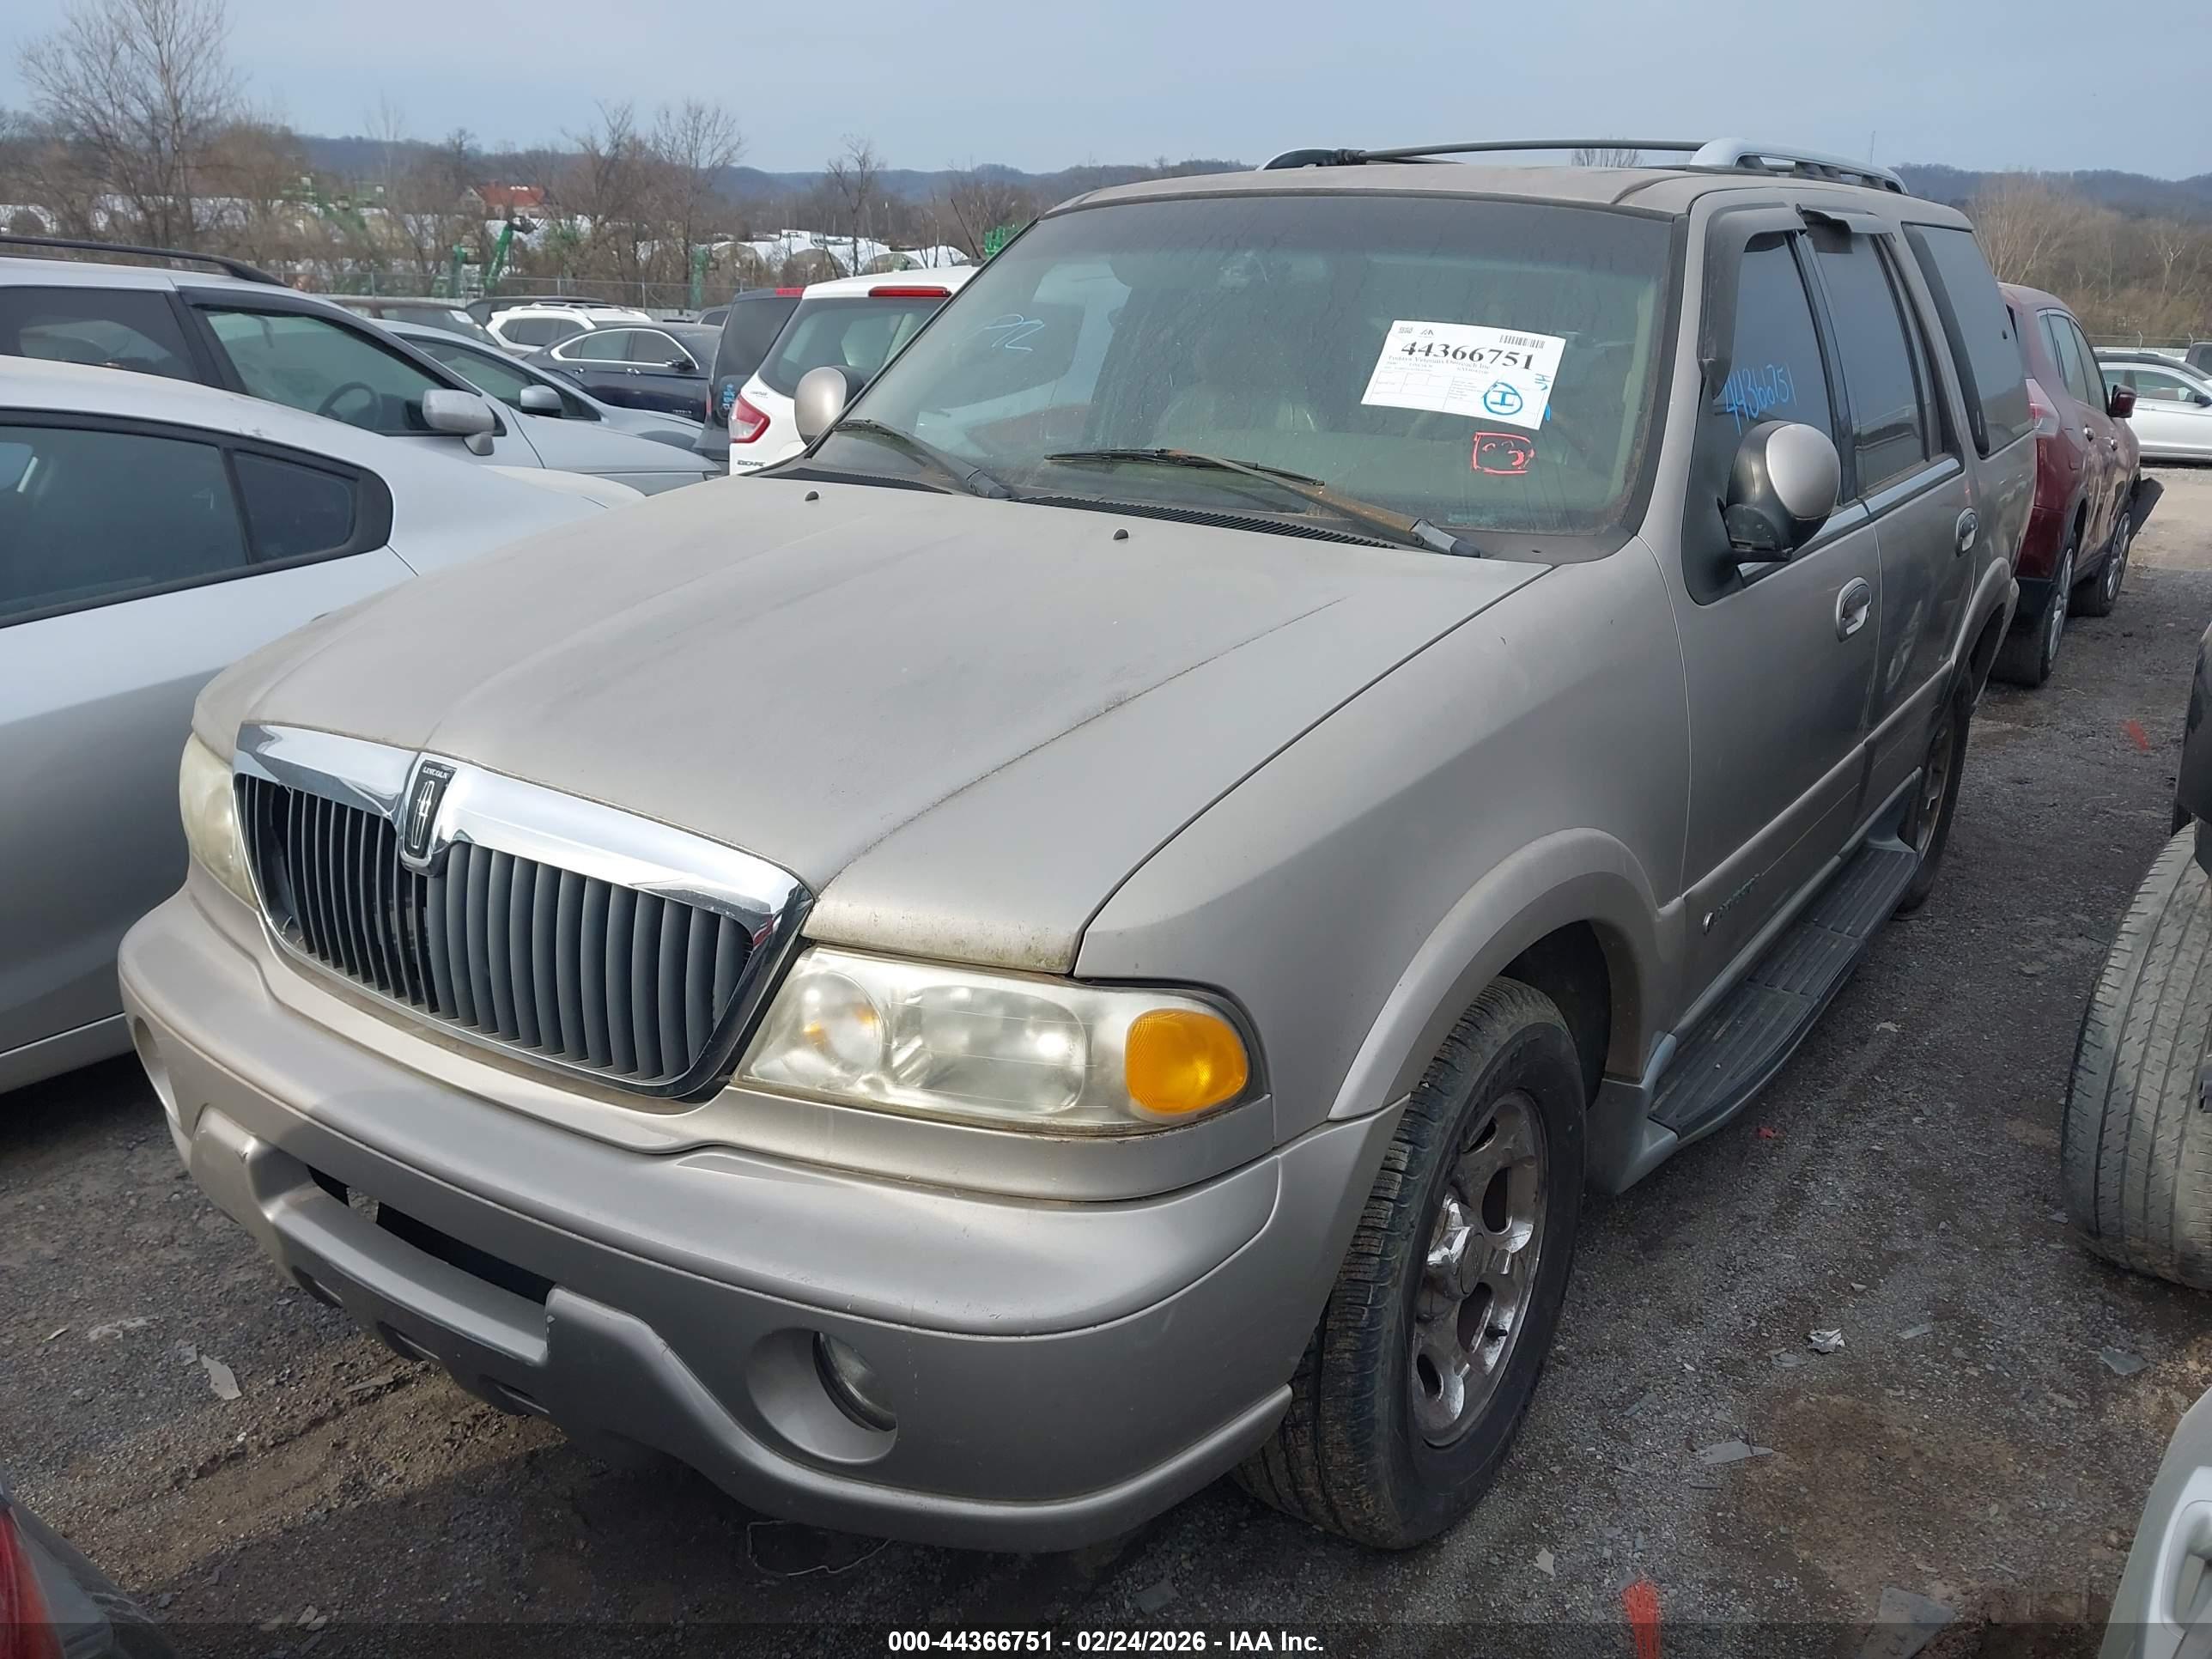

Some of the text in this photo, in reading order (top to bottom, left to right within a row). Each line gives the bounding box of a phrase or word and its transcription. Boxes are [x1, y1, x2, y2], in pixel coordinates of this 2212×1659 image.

[1401, 341, 1534, 371] 44366751
[1724, 362, 1798, 436] 44366751
[422, 766, 448, 779] LINCOLN
